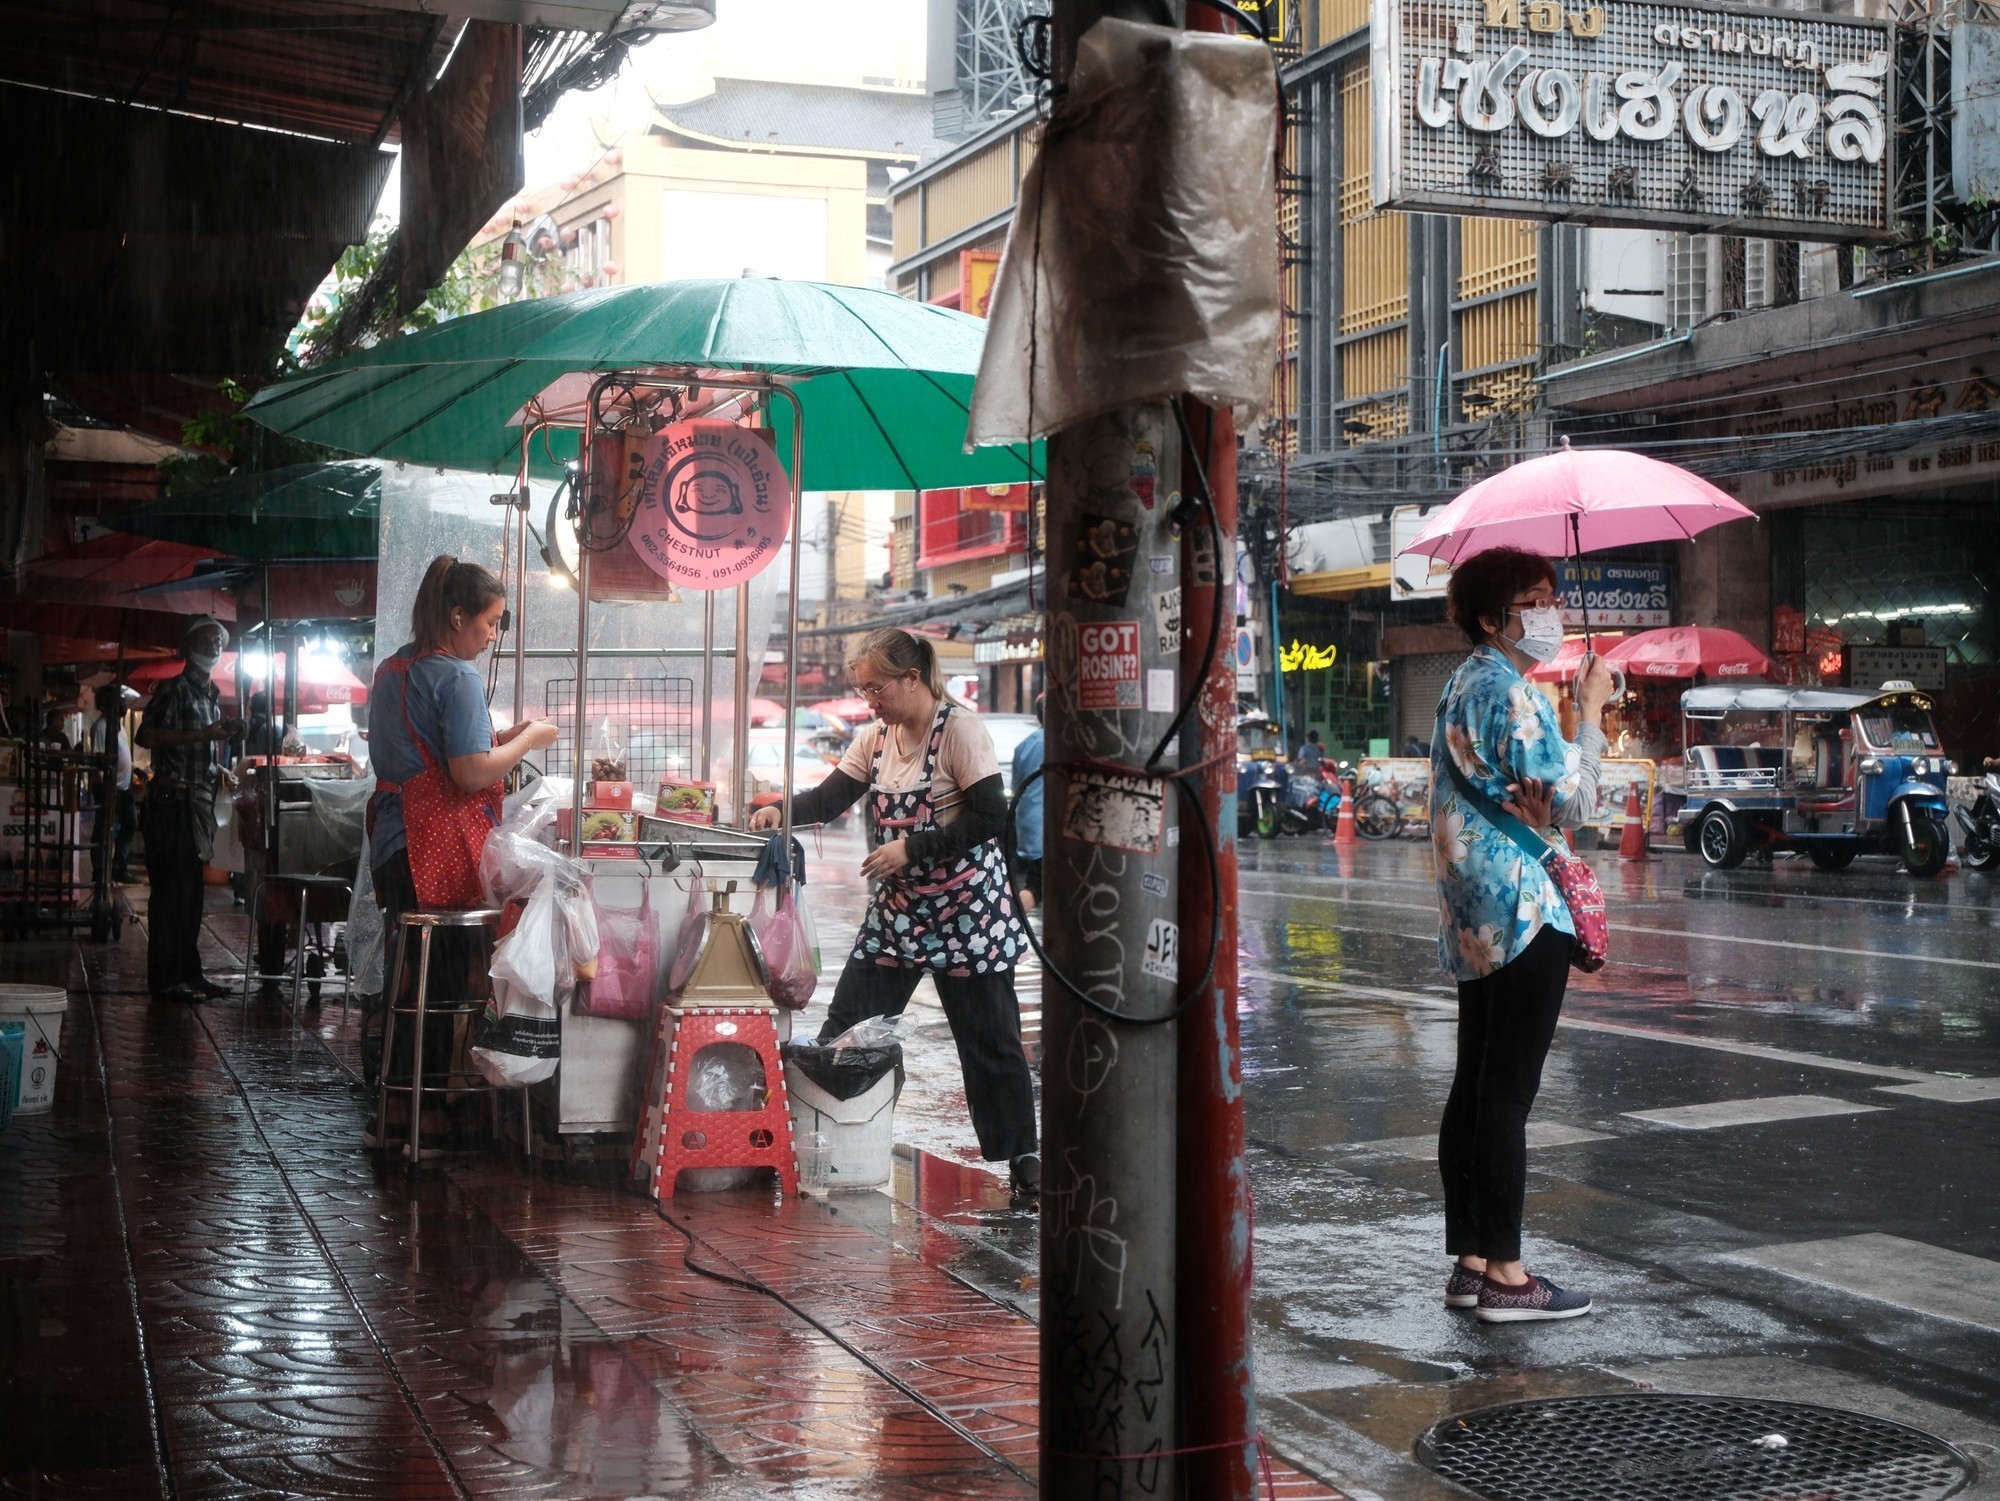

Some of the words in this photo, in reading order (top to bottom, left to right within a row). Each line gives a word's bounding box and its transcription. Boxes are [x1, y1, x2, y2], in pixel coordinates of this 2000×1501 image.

[641, 534, 701, 579] 062-5564956
[713, 536, 771, 579] 091-0936805
[658, 528, 721, 559] CHESTNUT
[1082, 626, 1135, 653] GOT
[1081, 655, 1137, 680] ROSIN??
